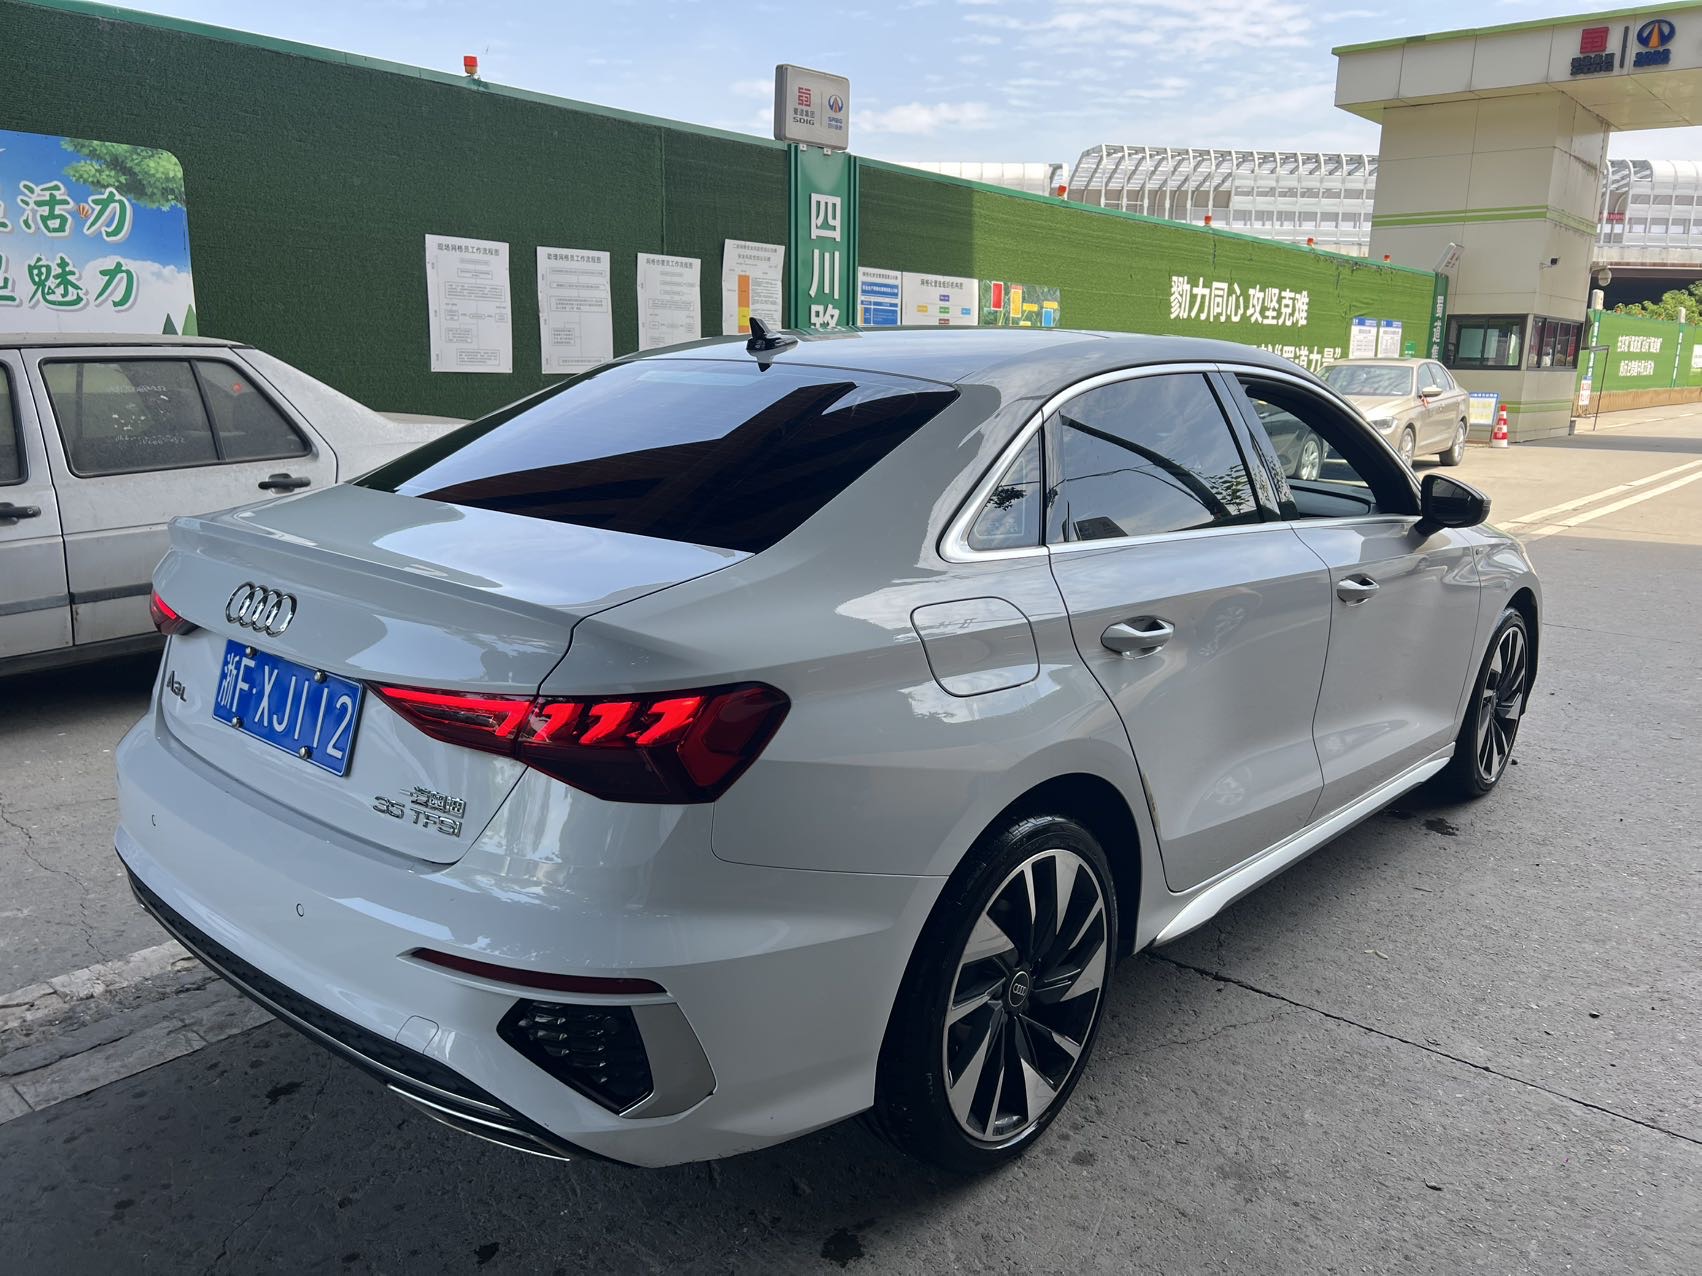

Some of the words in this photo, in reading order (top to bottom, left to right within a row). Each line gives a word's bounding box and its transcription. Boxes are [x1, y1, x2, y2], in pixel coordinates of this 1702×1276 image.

[793, 117, 815, 125] SDIG
[0, 181, 131, 241] 活力
[1246, 284, 1309, 327] 攻坚克难
[166, 670, 188, 703] A3L
[218, 652, 353, 760] 浙F·XJ112
[372, 796, 405, 819] 35
[410, 807, 463, 838] TFSI
